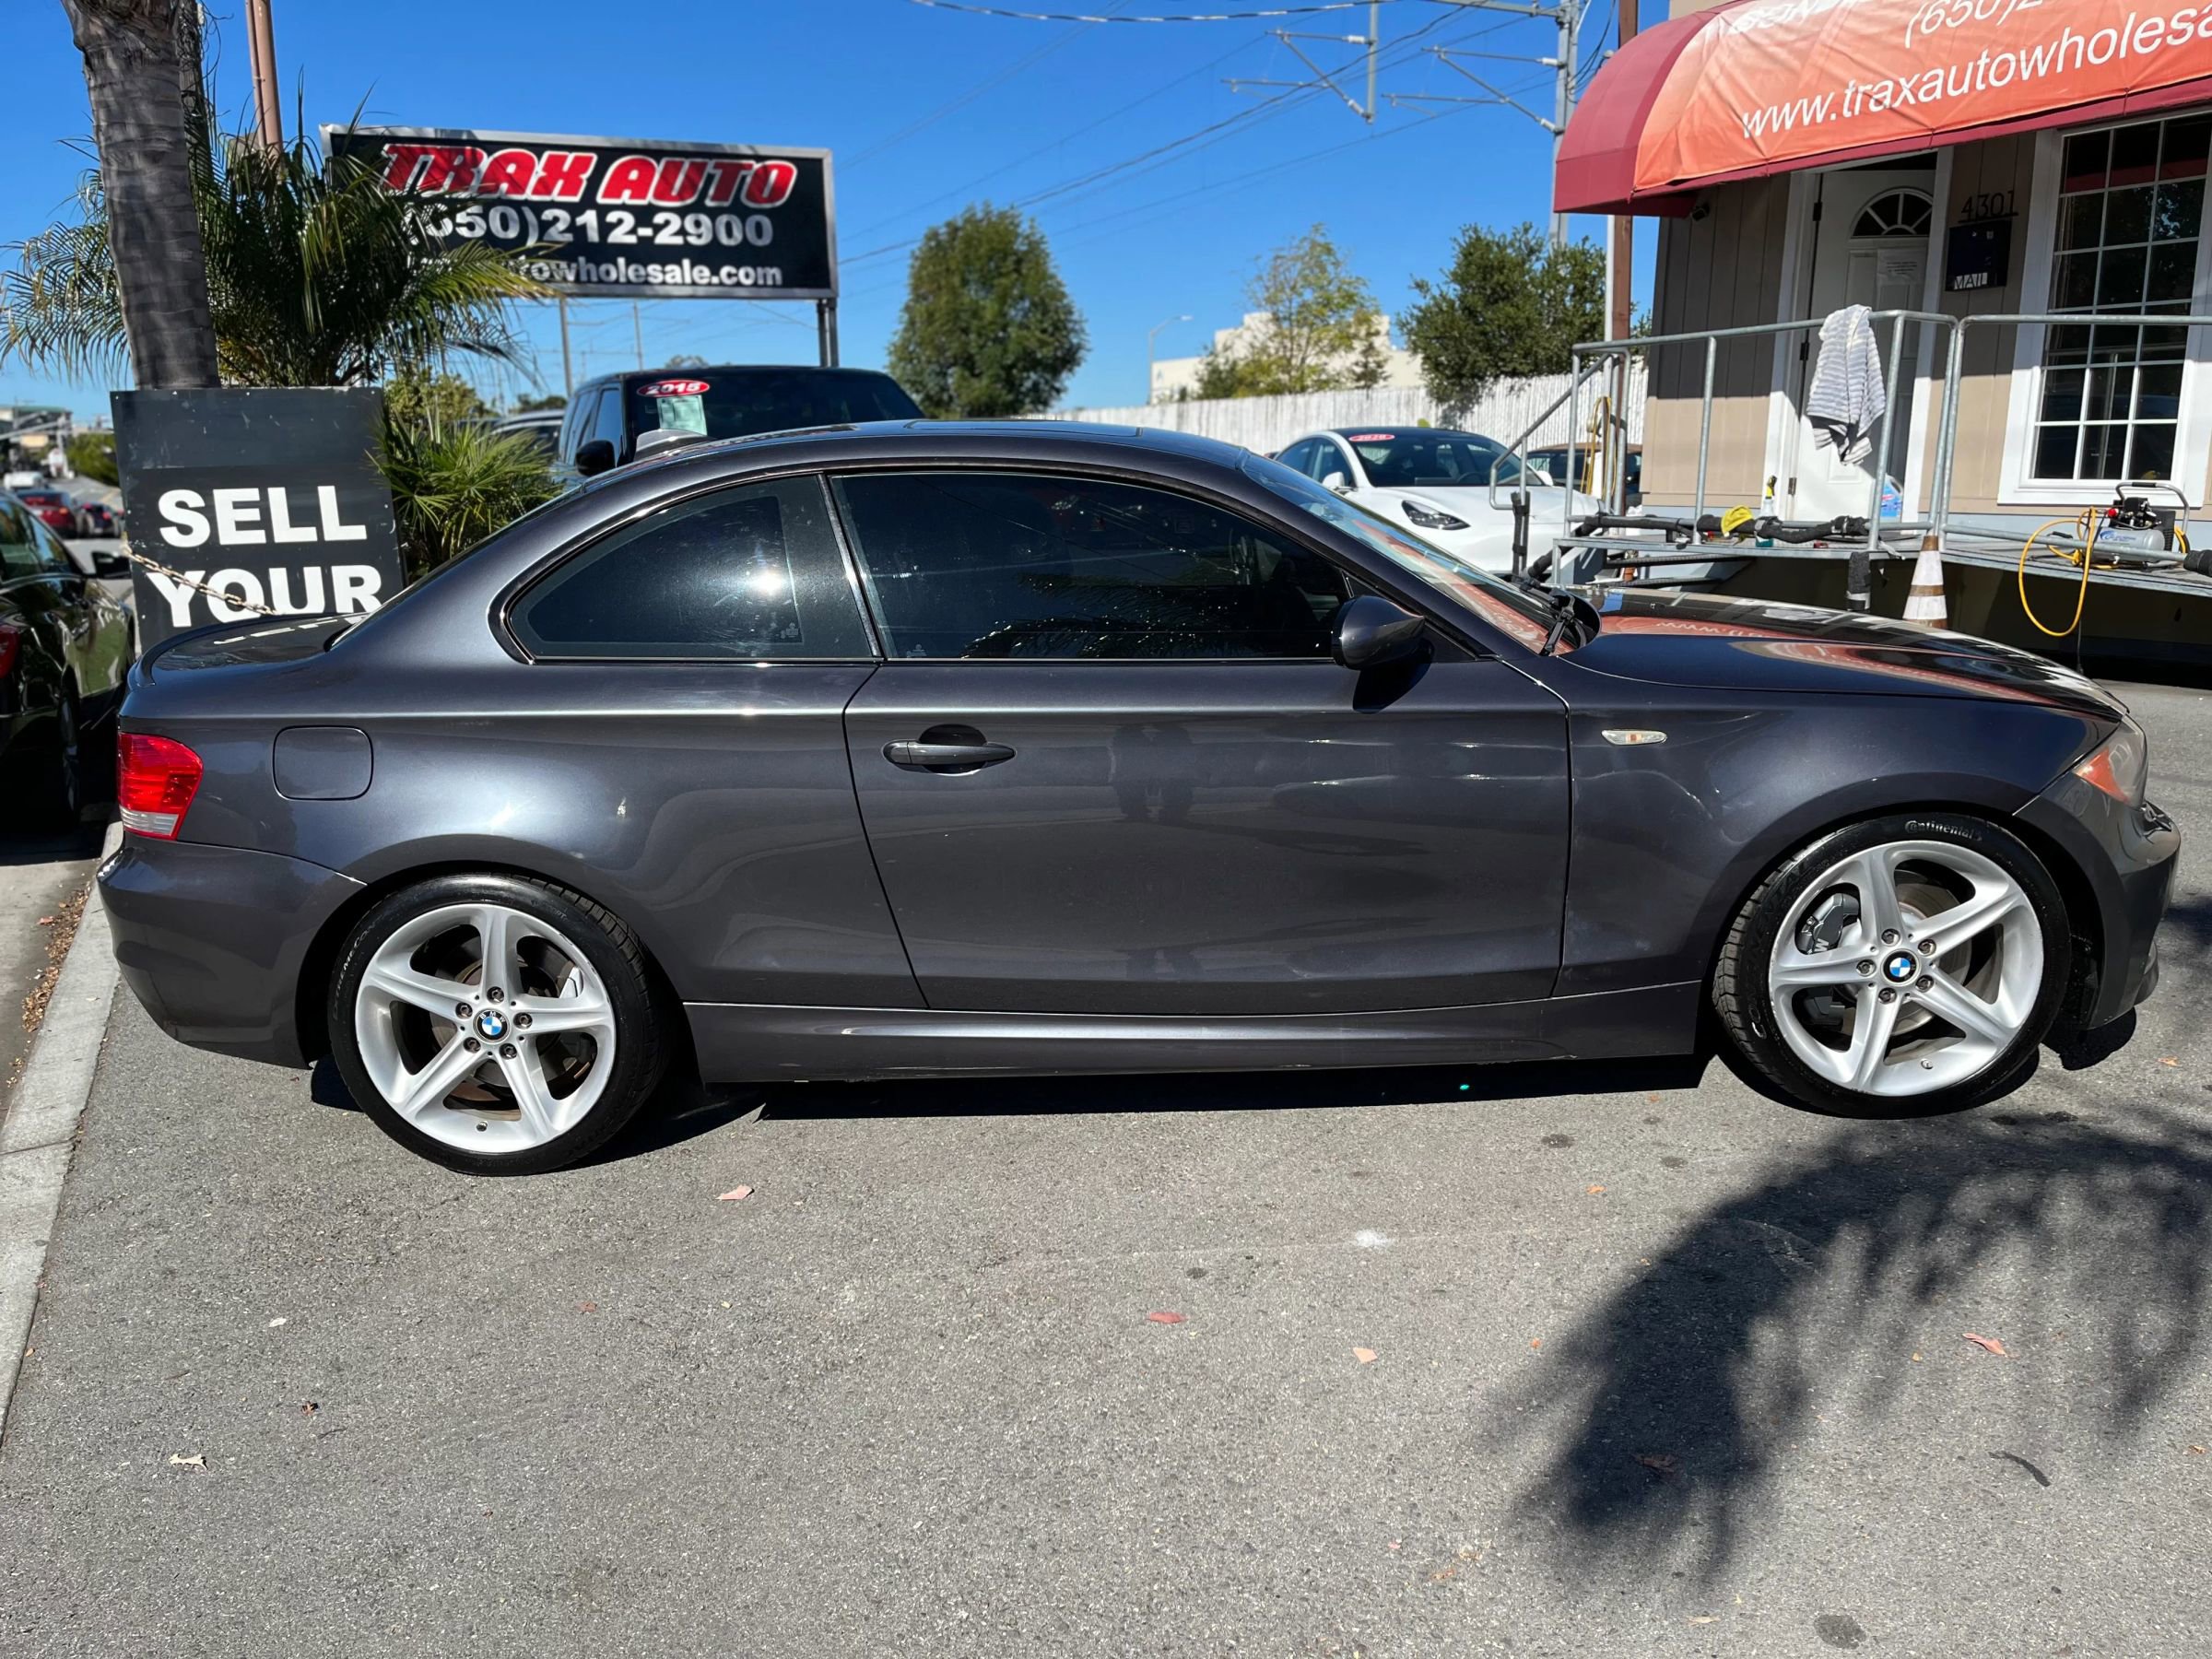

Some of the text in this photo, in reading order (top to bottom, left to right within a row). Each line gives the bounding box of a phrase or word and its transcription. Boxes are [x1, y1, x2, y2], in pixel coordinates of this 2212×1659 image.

[382, 143, 798, 208] TRAX AUTO
[1960, 190, 2018, 223] 4301
[158, 485, 368, 548] SELL
[146, 564, 382, 628] YOUR
